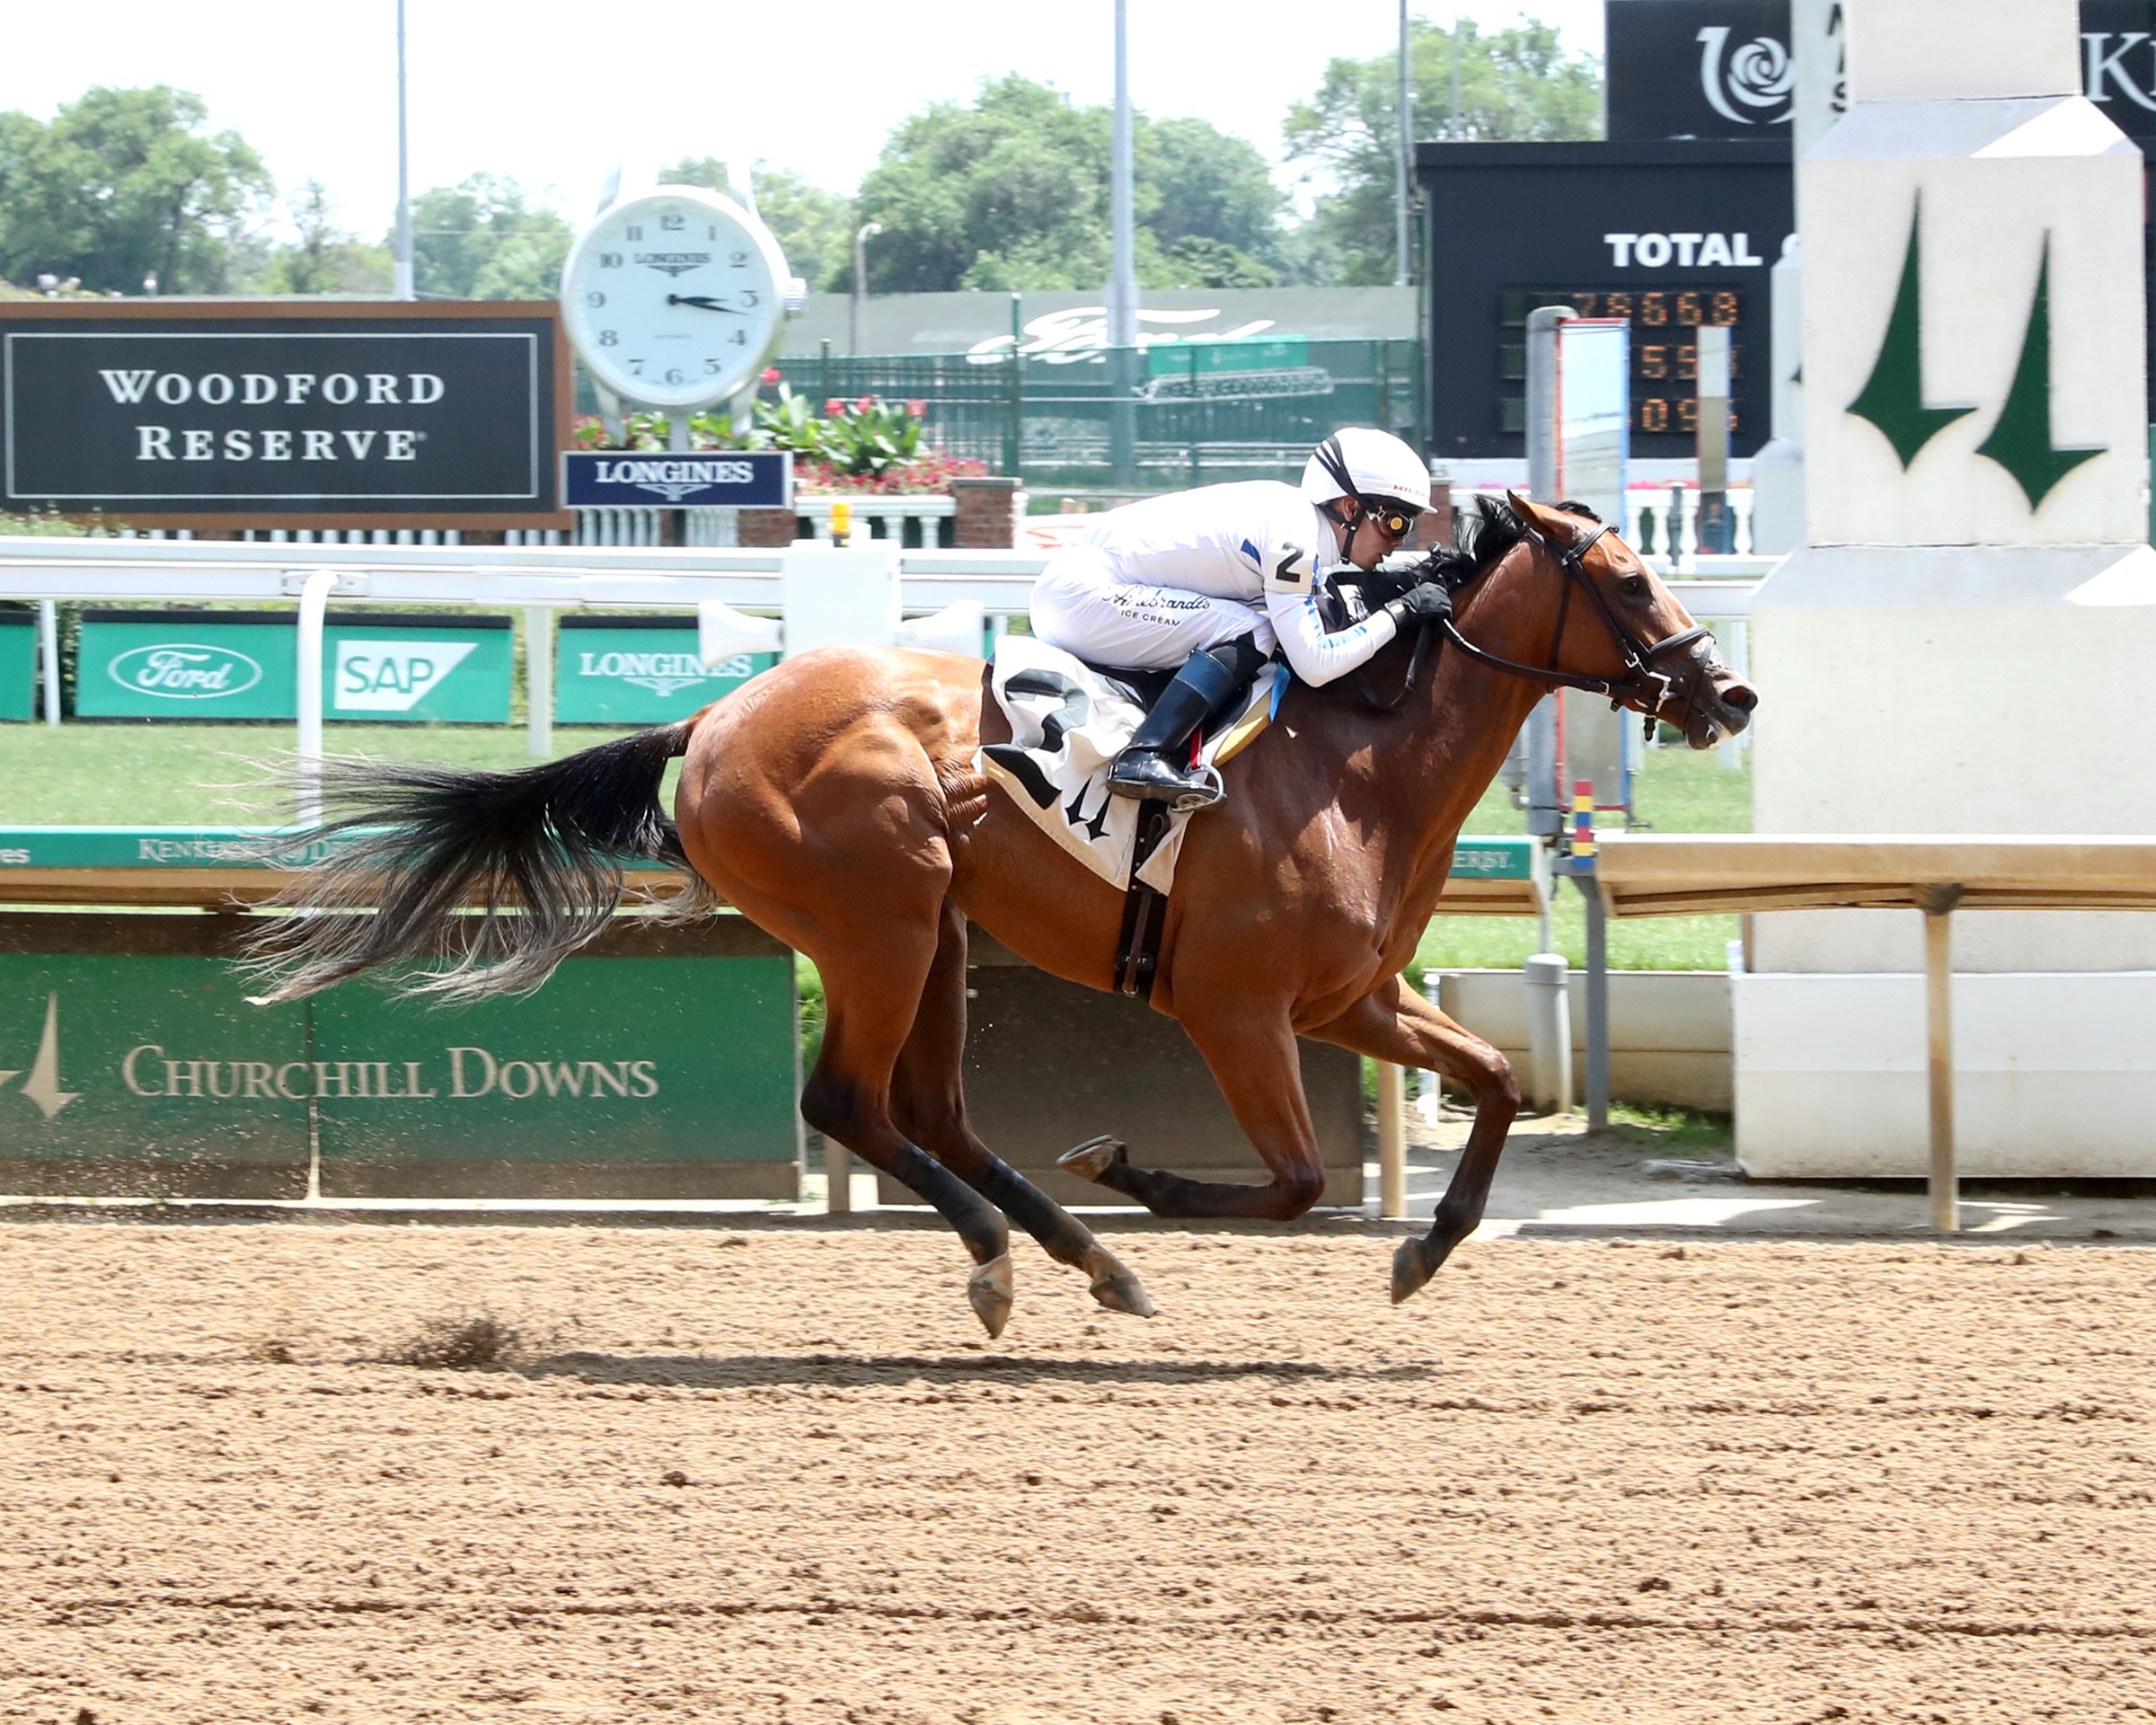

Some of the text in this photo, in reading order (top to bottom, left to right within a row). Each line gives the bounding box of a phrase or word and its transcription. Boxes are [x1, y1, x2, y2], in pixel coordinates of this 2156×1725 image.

[660, 215, 685, 231] 12
[626, 226, 643, 242] 11
[708, 226, 716, 242] 1
[1604, 233, 1763, 268] TOTAL
[600, 252, 623, 269] 10
[729, 252, 747, 268] 2
[588, 291, 605, 308] 9
[740, 289, 759, 307] 3
[599, 330, 619, 347] 8
[728, 329, 747, 346] 4
[627, 358, 645, 376] 7
[703, 358, 720, 375] 5
[665, 368, 684, 385] 6
[98, 369, 446, 405] WOODFORD
[595, 461, 755, 483] LONGINES
[1275, 541, 1304, 583] 2
[1120, 609, 1182, 627] ICE CREAM
[137, 650, 234, 690] Ford
[343, 655, 434, 694] SAP
[0, 848, 31, 864] es
[1452, 850, 1511, 871] ERBY
[121, 1044, 660, 1100] CHURCHILL DOWNS
